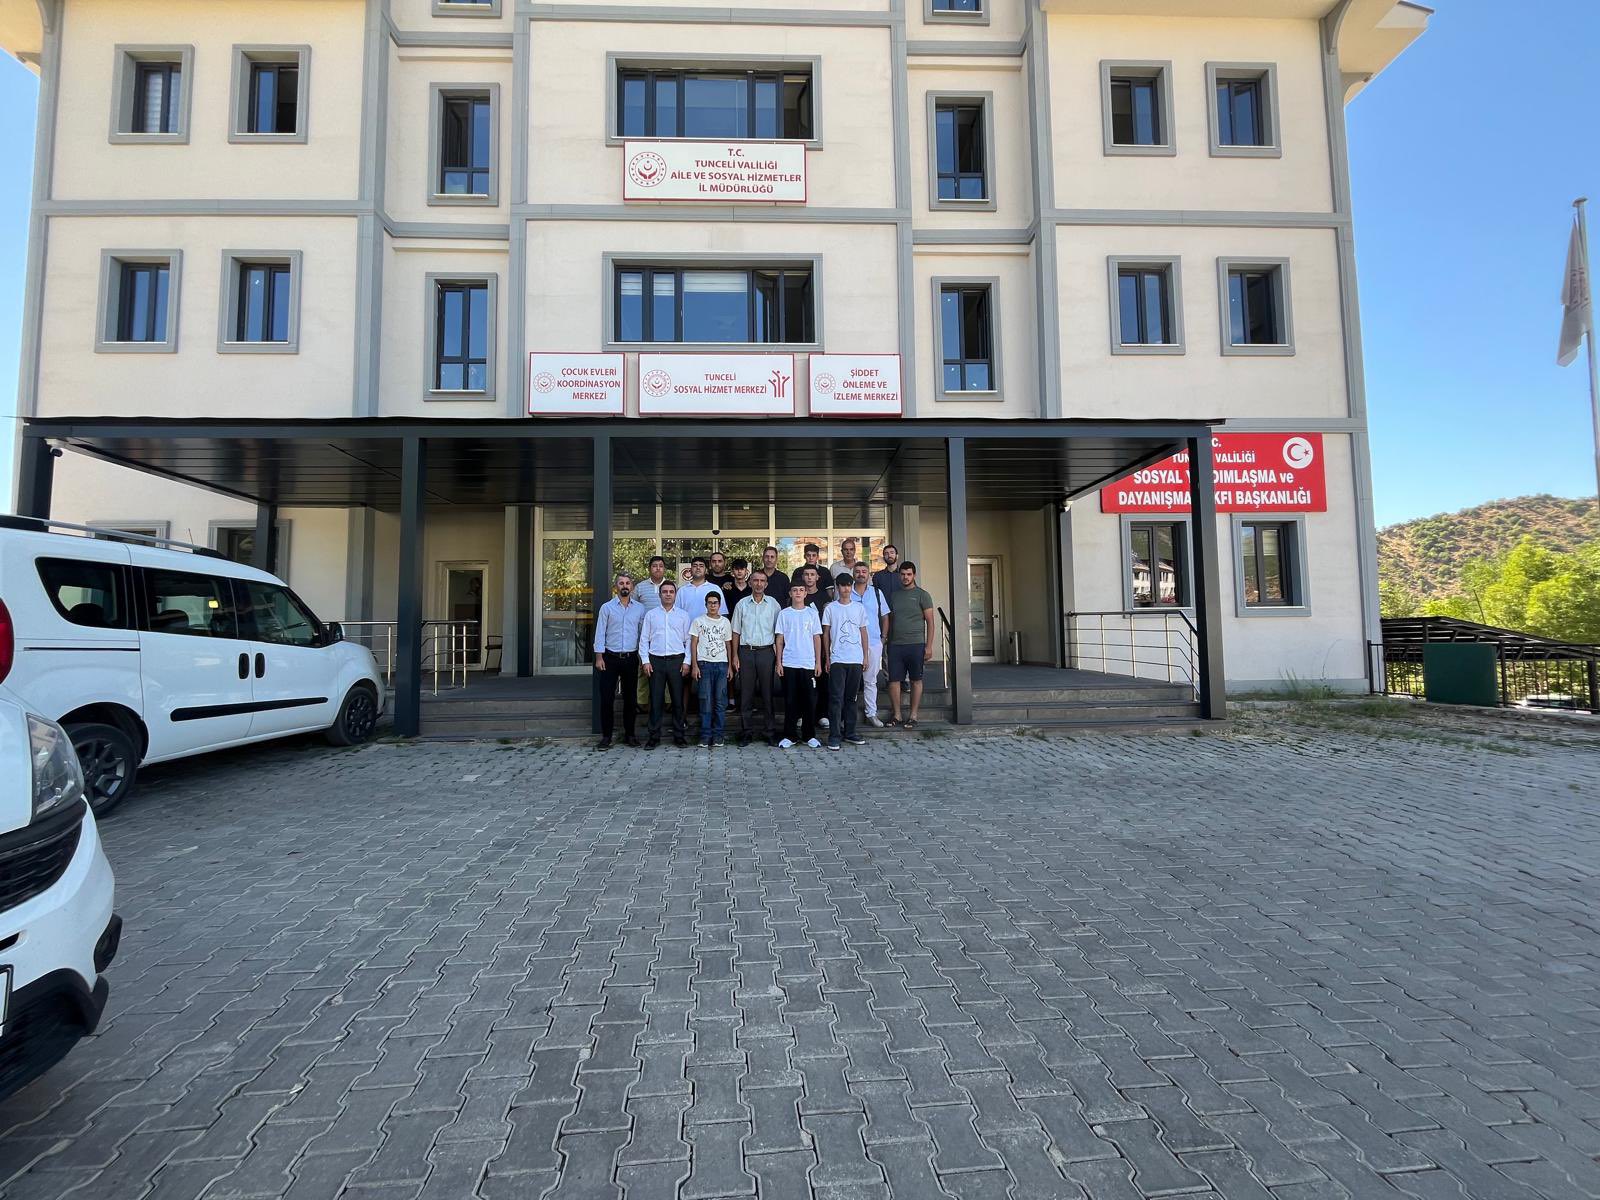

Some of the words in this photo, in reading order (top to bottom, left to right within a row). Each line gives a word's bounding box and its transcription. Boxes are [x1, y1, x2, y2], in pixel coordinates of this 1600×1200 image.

[728, 148, 745, 157] T.C.
[695, 160, 736, 168] TUNCELİ
[737, 160, 777, 170] VALİLİĞİ
[670, 170, 691, 179] AİLE
[708, 172, 745, 181] SOSYAL
[747, 172, 801, 182] HİZMETLER
[699, 183, 707, 192] İL
[709, 183, 773, 193] MÜDÜRLÜĞÜ
[561, 368, 589, 377] ÇOCUK
[590, 367, 617, 376] EVLERİ
[704, 373, 736, 381] TUNCELİ
[850, 368, 879, 378] ŞİDDET
[557, 379, 621, 388] KOORDİNASYON
[842, 380, 876, 389] ÖNLEME
[877, 381, 888, 389] VE
[673, 386, 702, 394] SOSYAL
[704, 384, 732, 394] HİZMET
[735, 384, 767, 394] MERKEZİ
[572, 391, 607, 400] MERKEZİ
[833, 392, 862, 400] İZLEME
[863, 392, 898, 400] MERKEZİ
[1215, 451, 1255, 463] VALİLİĞİ
[1133, 470, 1183, 484] SOSYAL
[1279, 472, 1294, 484] ve
[1118, 491, 1192, 509] DAYANIŞMA
[1214, 490, 1232, 505] KFI
[1236, 487, 1311, 508] BAŞKANLIĞI
